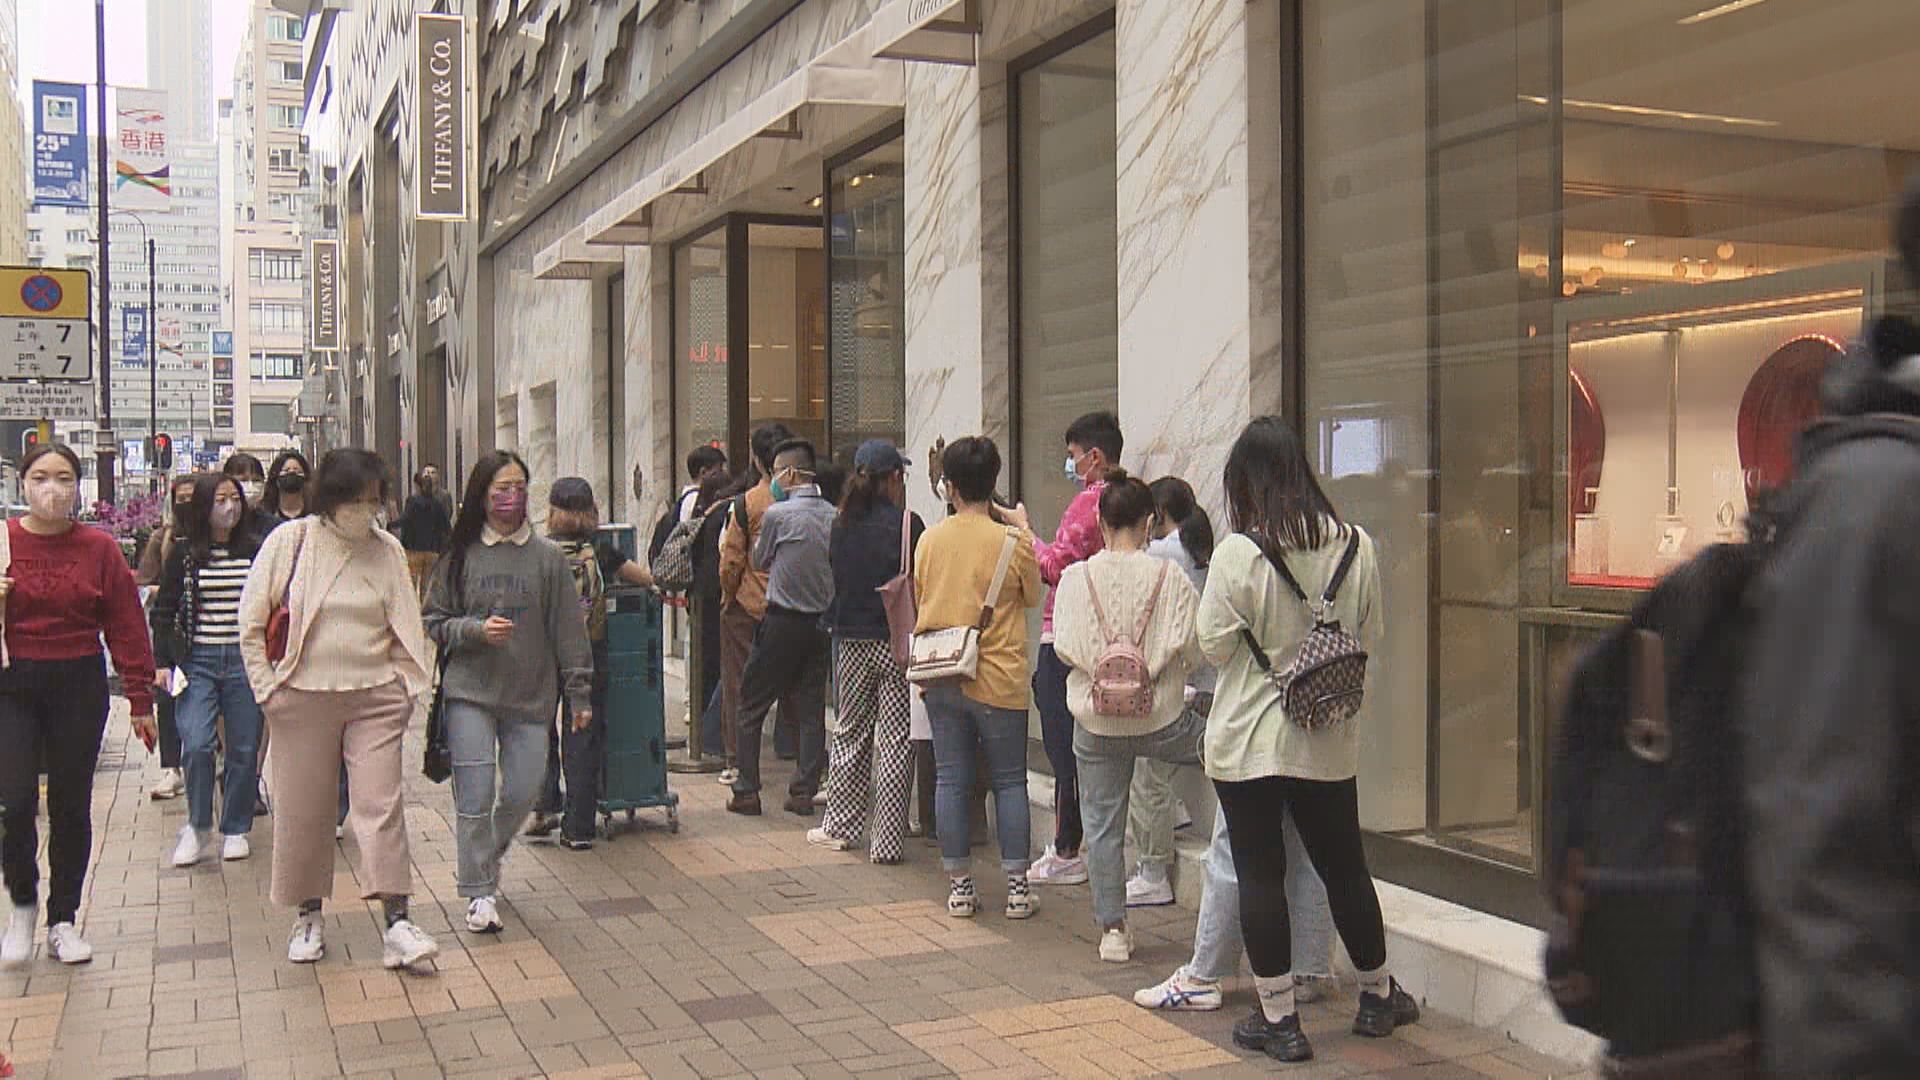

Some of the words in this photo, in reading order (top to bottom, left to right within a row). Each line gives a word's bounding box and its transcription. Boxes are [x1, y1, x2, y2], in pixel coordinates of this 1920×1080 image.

[121, 129, 166, 151] 香港
[431, 98, 452, 194] TIFFANY
[18, 321, 35, 329] am
[14, 331, 39, 342] 上午
[56, 324, 72, 343] 7
[18, 352, 36, 362] pm
[14, 363, 40, 374] 下午
[56, 355, 72, 374] 7
[17, 386, 52, 396] Except
[53, 386, 72, 395] taxi
[4, 396, 26, 405] pick
[28, 397, 67, 406] up/drop
[69, 396, 84, 404] off
